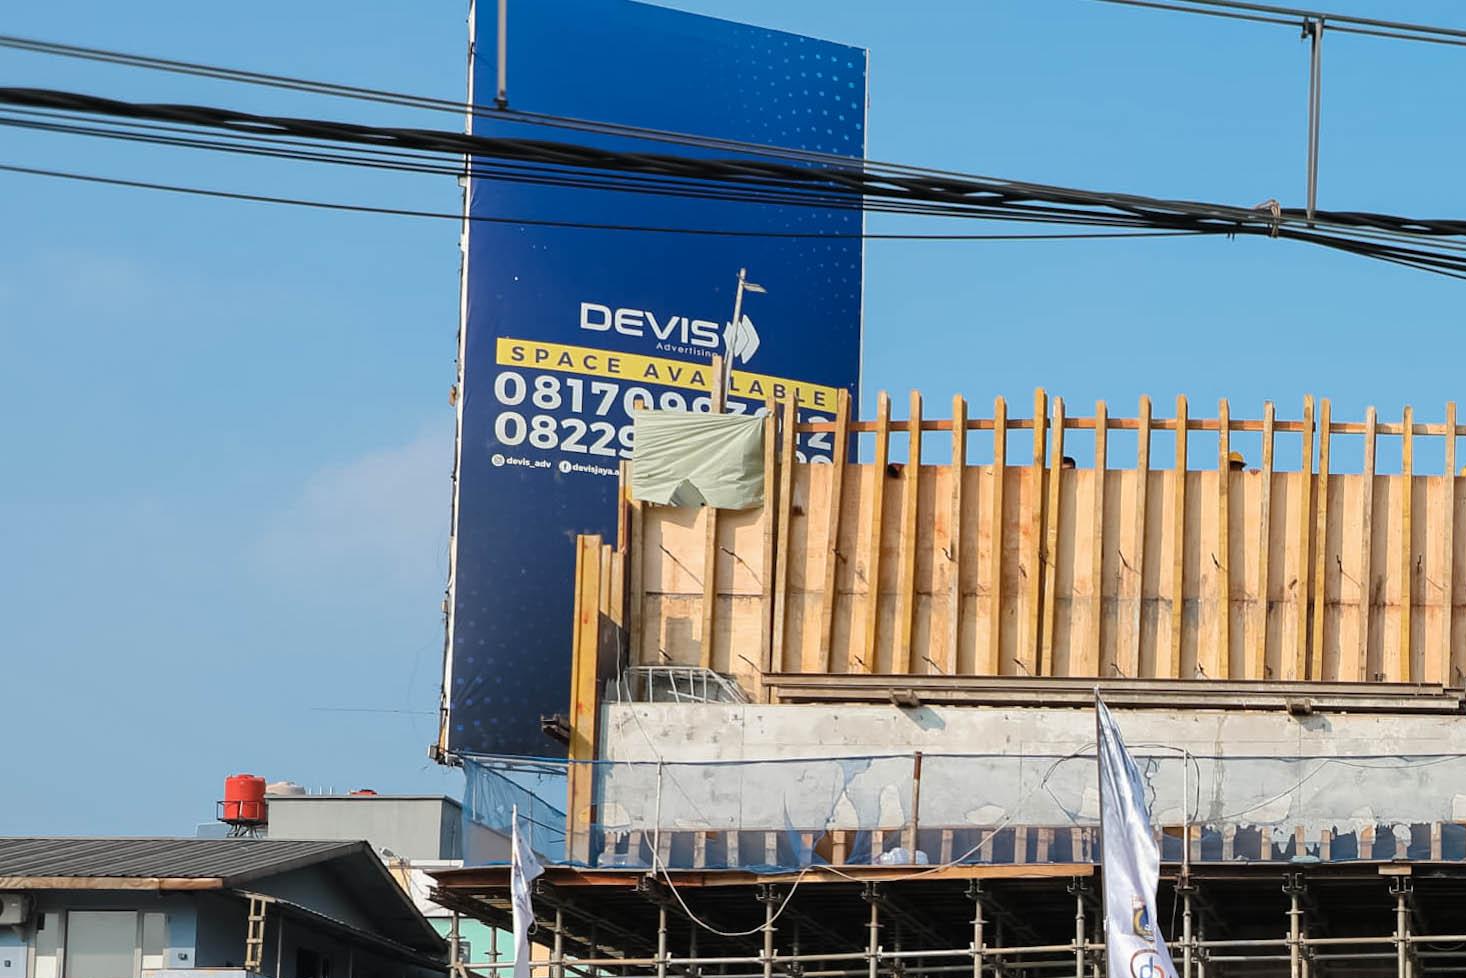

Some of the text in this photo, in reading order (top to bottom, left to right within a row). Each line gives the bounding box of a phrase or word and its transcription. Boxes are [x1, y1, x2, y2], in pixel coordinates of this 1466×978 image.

[580, 302, 719, 348] DEVIS
[511, 346, 825, 406] SPACE AVALABLE
[506, 457, 551, 468] devis_adv
